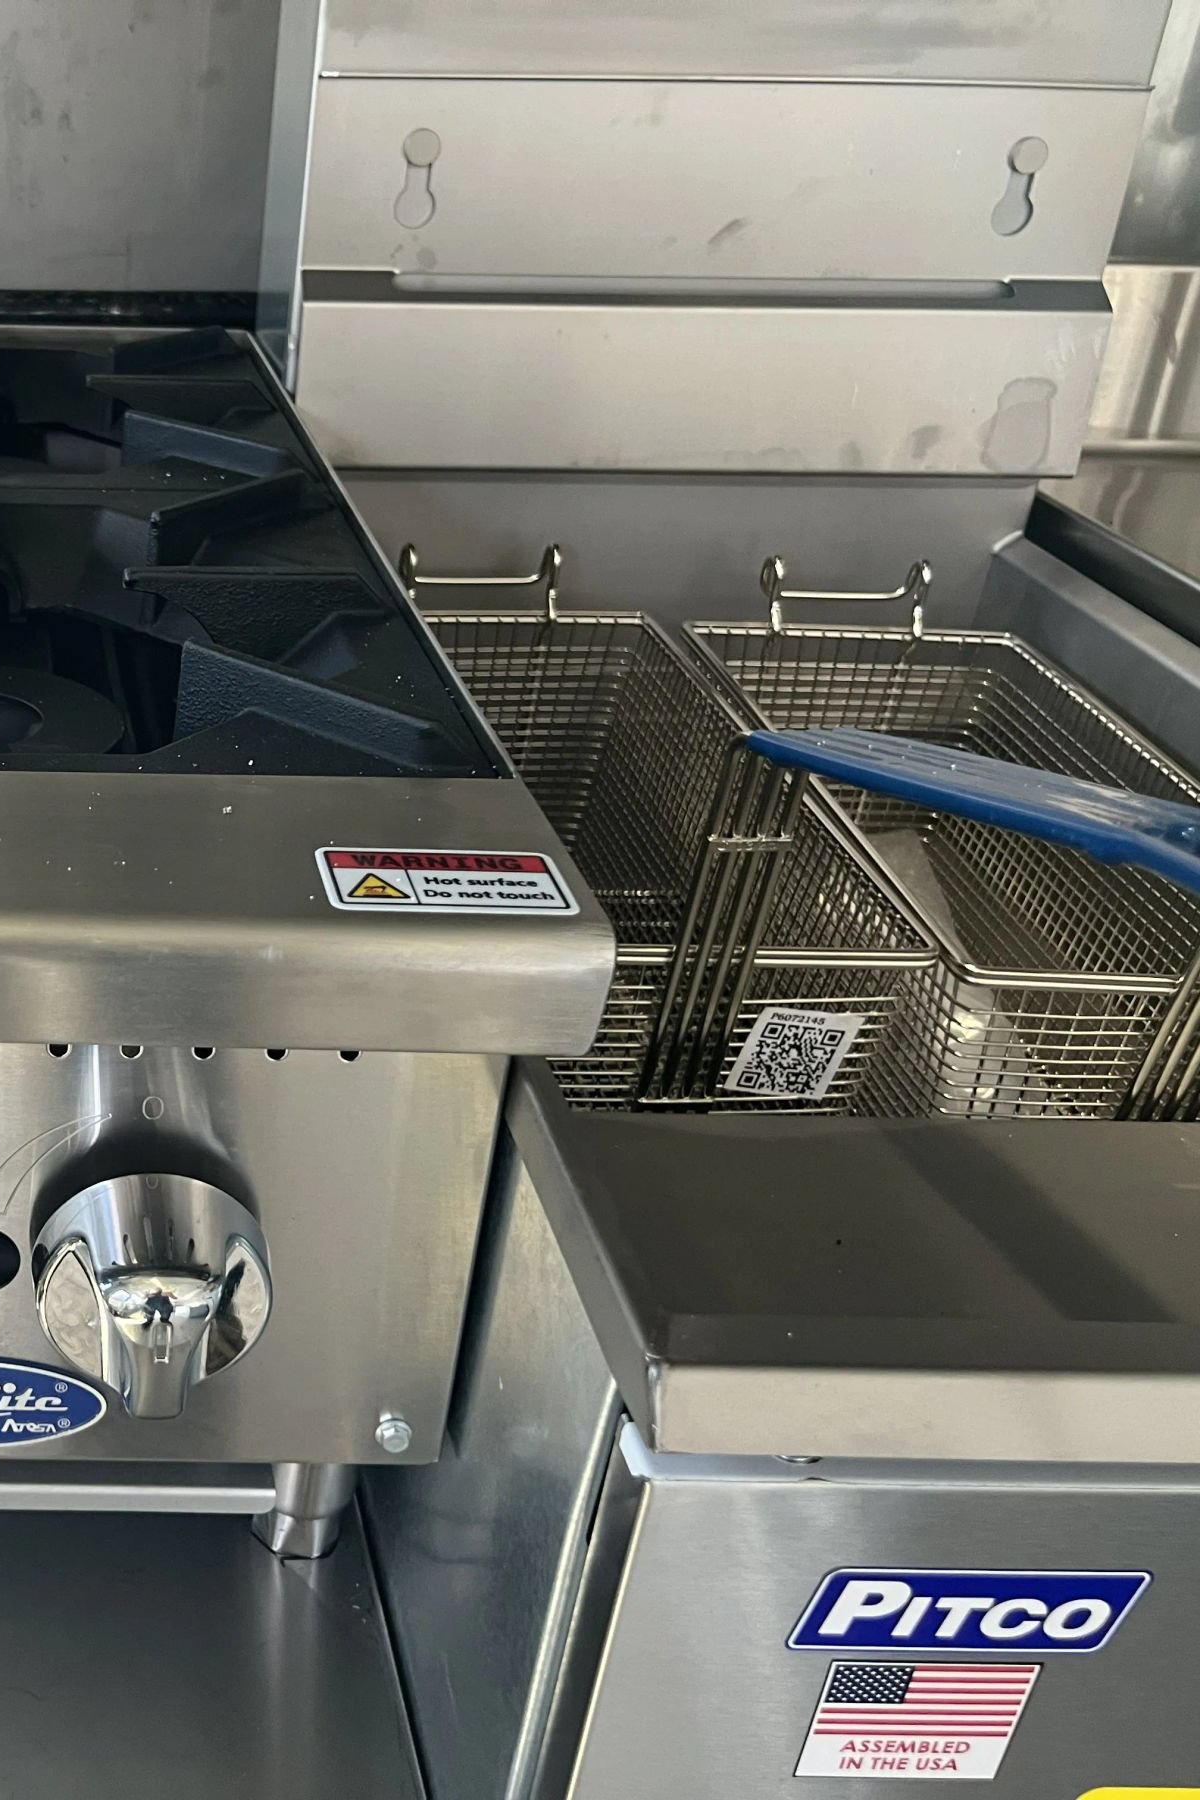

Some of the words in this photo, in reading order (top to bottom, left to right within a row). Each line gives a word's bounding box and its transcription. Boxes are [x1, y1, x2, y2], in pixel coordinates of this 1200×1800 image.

[352, 855, 522, 870] WARNING
[424, 877, 462, 885] Hot
[467, 878, 538, 887] surface
[424, 890, 452, 898] Do
[458, 891, 493, 899] not
[497, 892, 555, 900] touch
[817, 1580, 1112, 1639] PITCO
[840, 1740, 971, 1754] ASSEMBLED
[839, 1757, 863, 1769] IN
[871, 1757, 908, 1770] THE
[915, 1758, 958, 1771] USA
